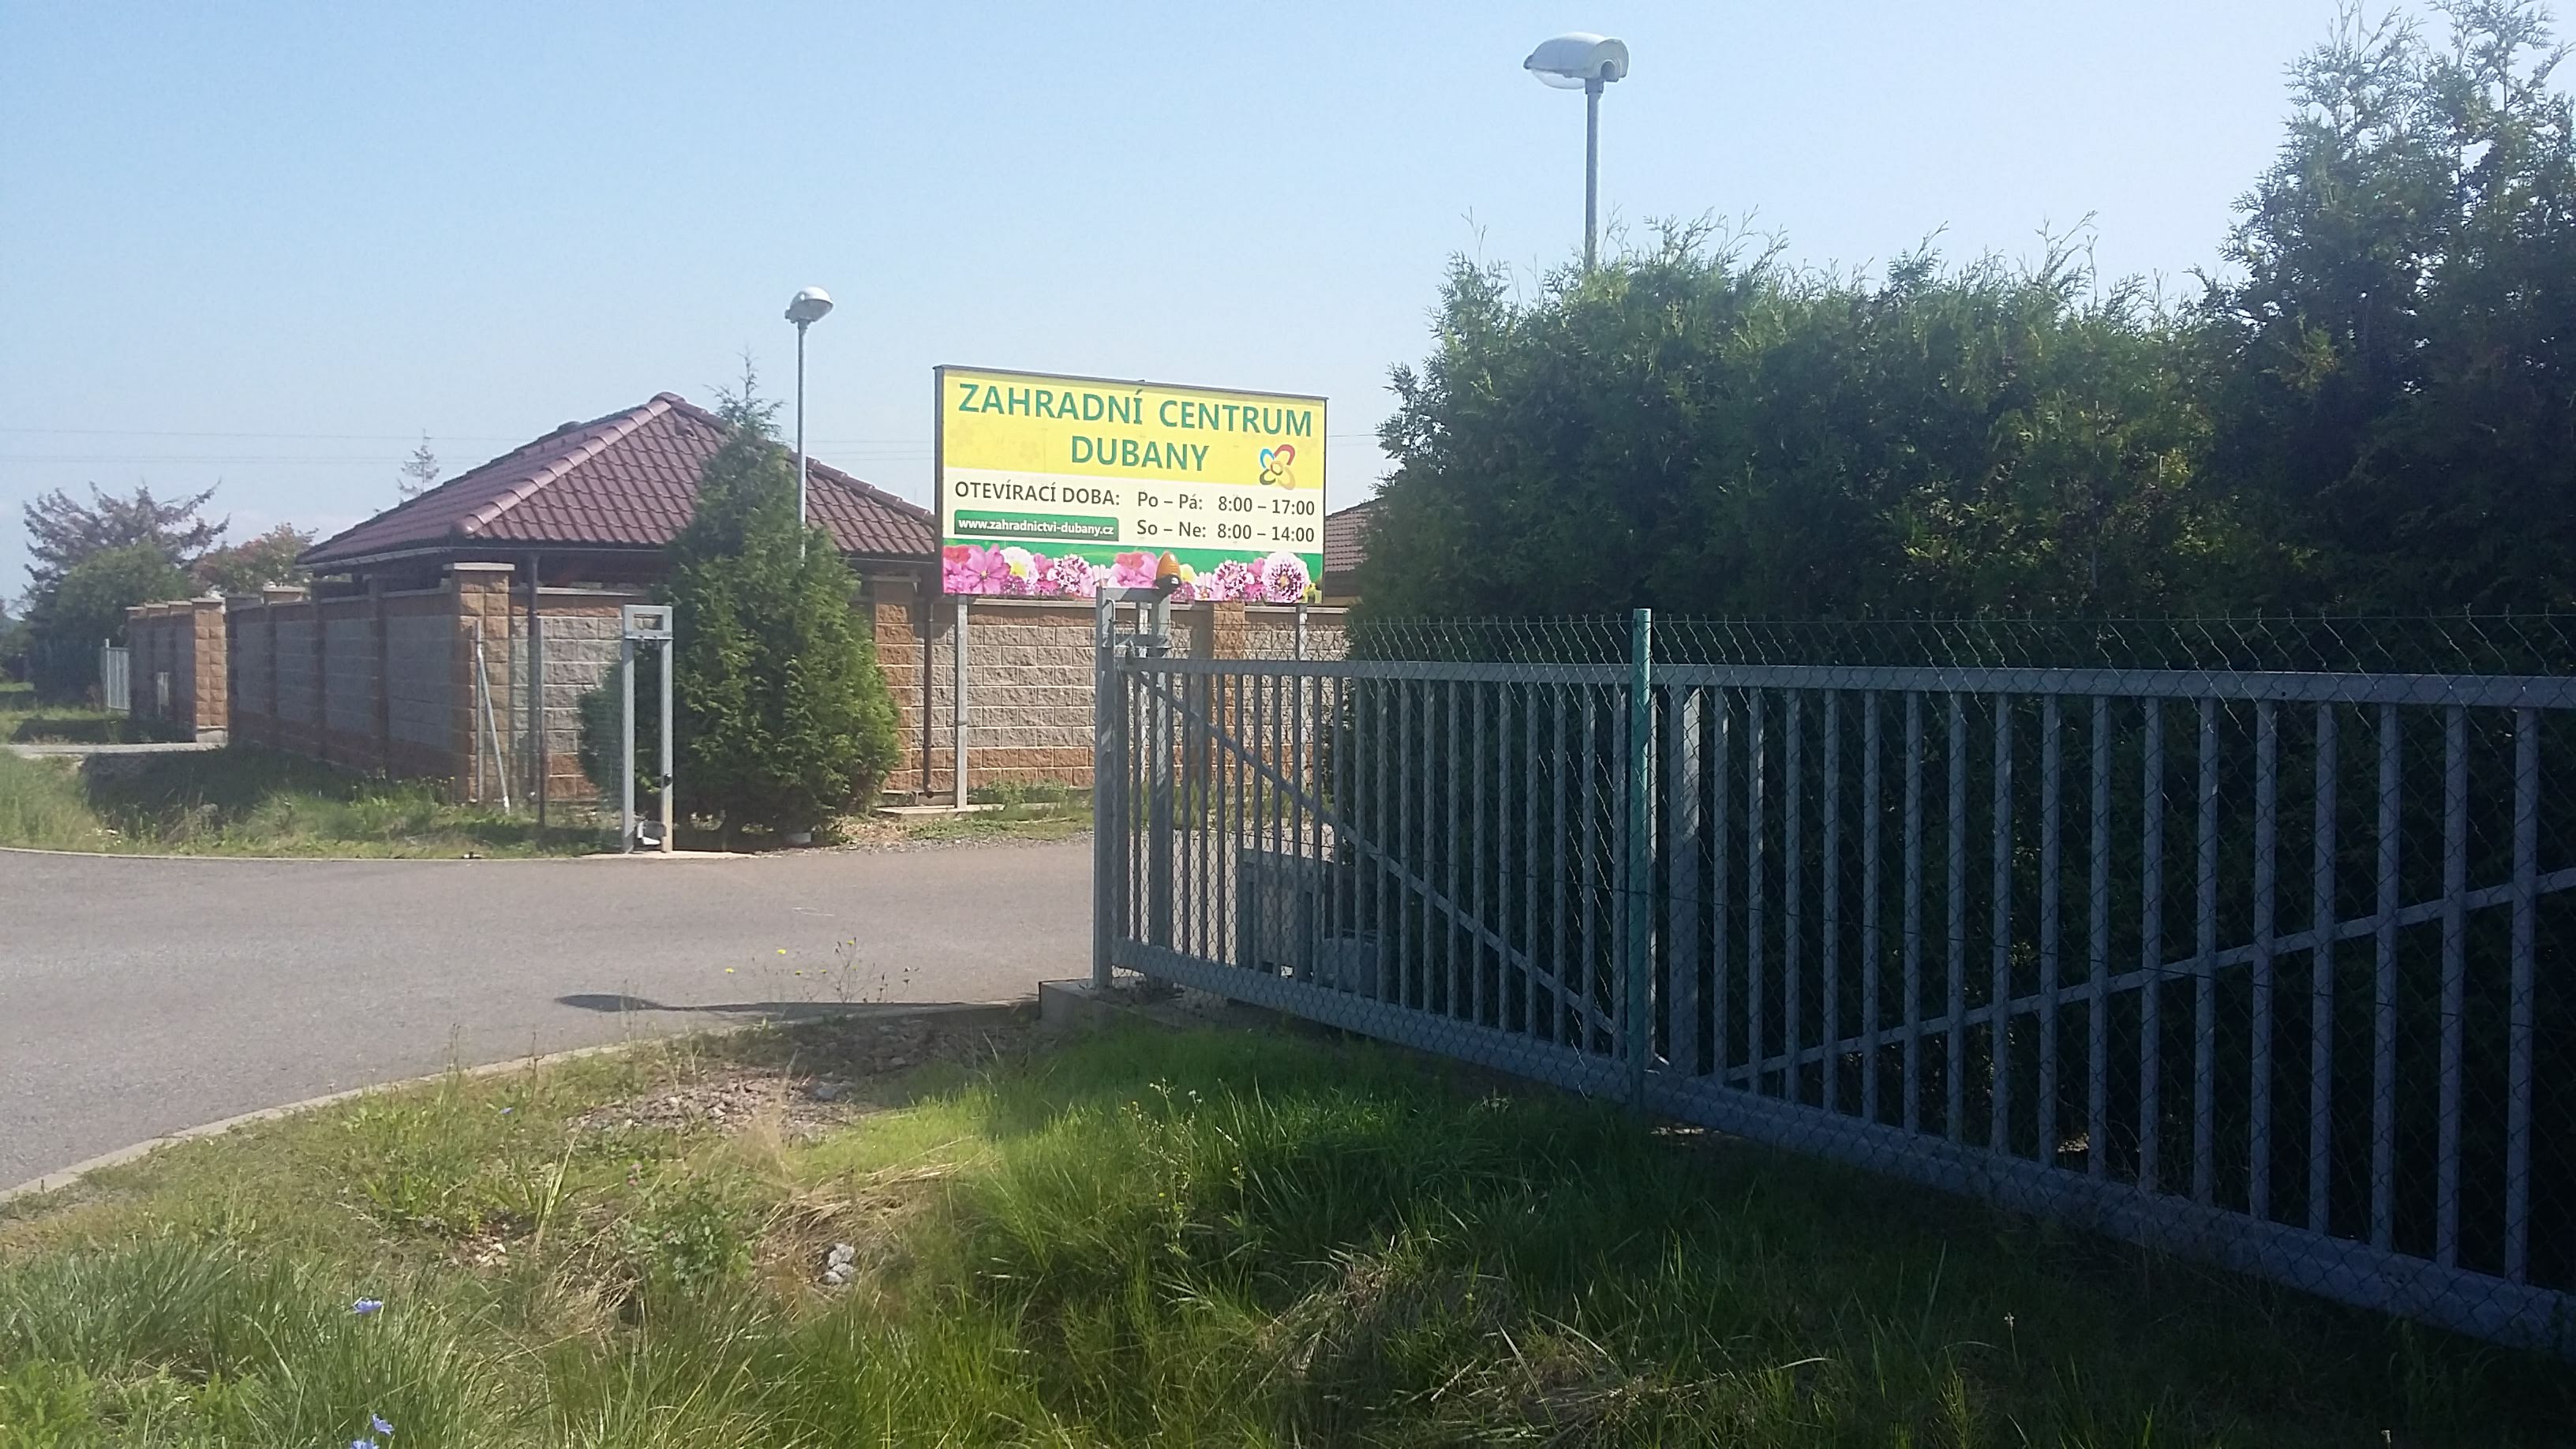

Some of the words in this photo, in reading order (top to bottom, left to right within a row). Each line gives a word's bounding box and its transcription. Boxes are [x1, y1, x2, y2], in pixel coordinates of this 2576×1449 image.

[958, 383, 1143, 425] ZAHRADNÍ
[1159, 400, 1312, 437] CENTRUM
[1072, 436, 1210, 472] DUBANY
[955, 479, 1057, 502] OTEVÍRACÍ
[1063, 487, 1120, 506] DOBA:
[1137, 492, 1159, 508] Po
[1179, 493, 1203, 510] Pá:
[1218, 496, 1252, 512] 8:00
[1271, 500, 1315, 515] 17:00
[957, 519, 1114, 536] www.zahradnictvi-dubany.cz
[1136, 520, 1159, 535] So
[1178, 521, 1206, 538] Ne:
[1217, 523, 1252, 540] 8:00
[1271, 527, 1315, 542] 14:00
